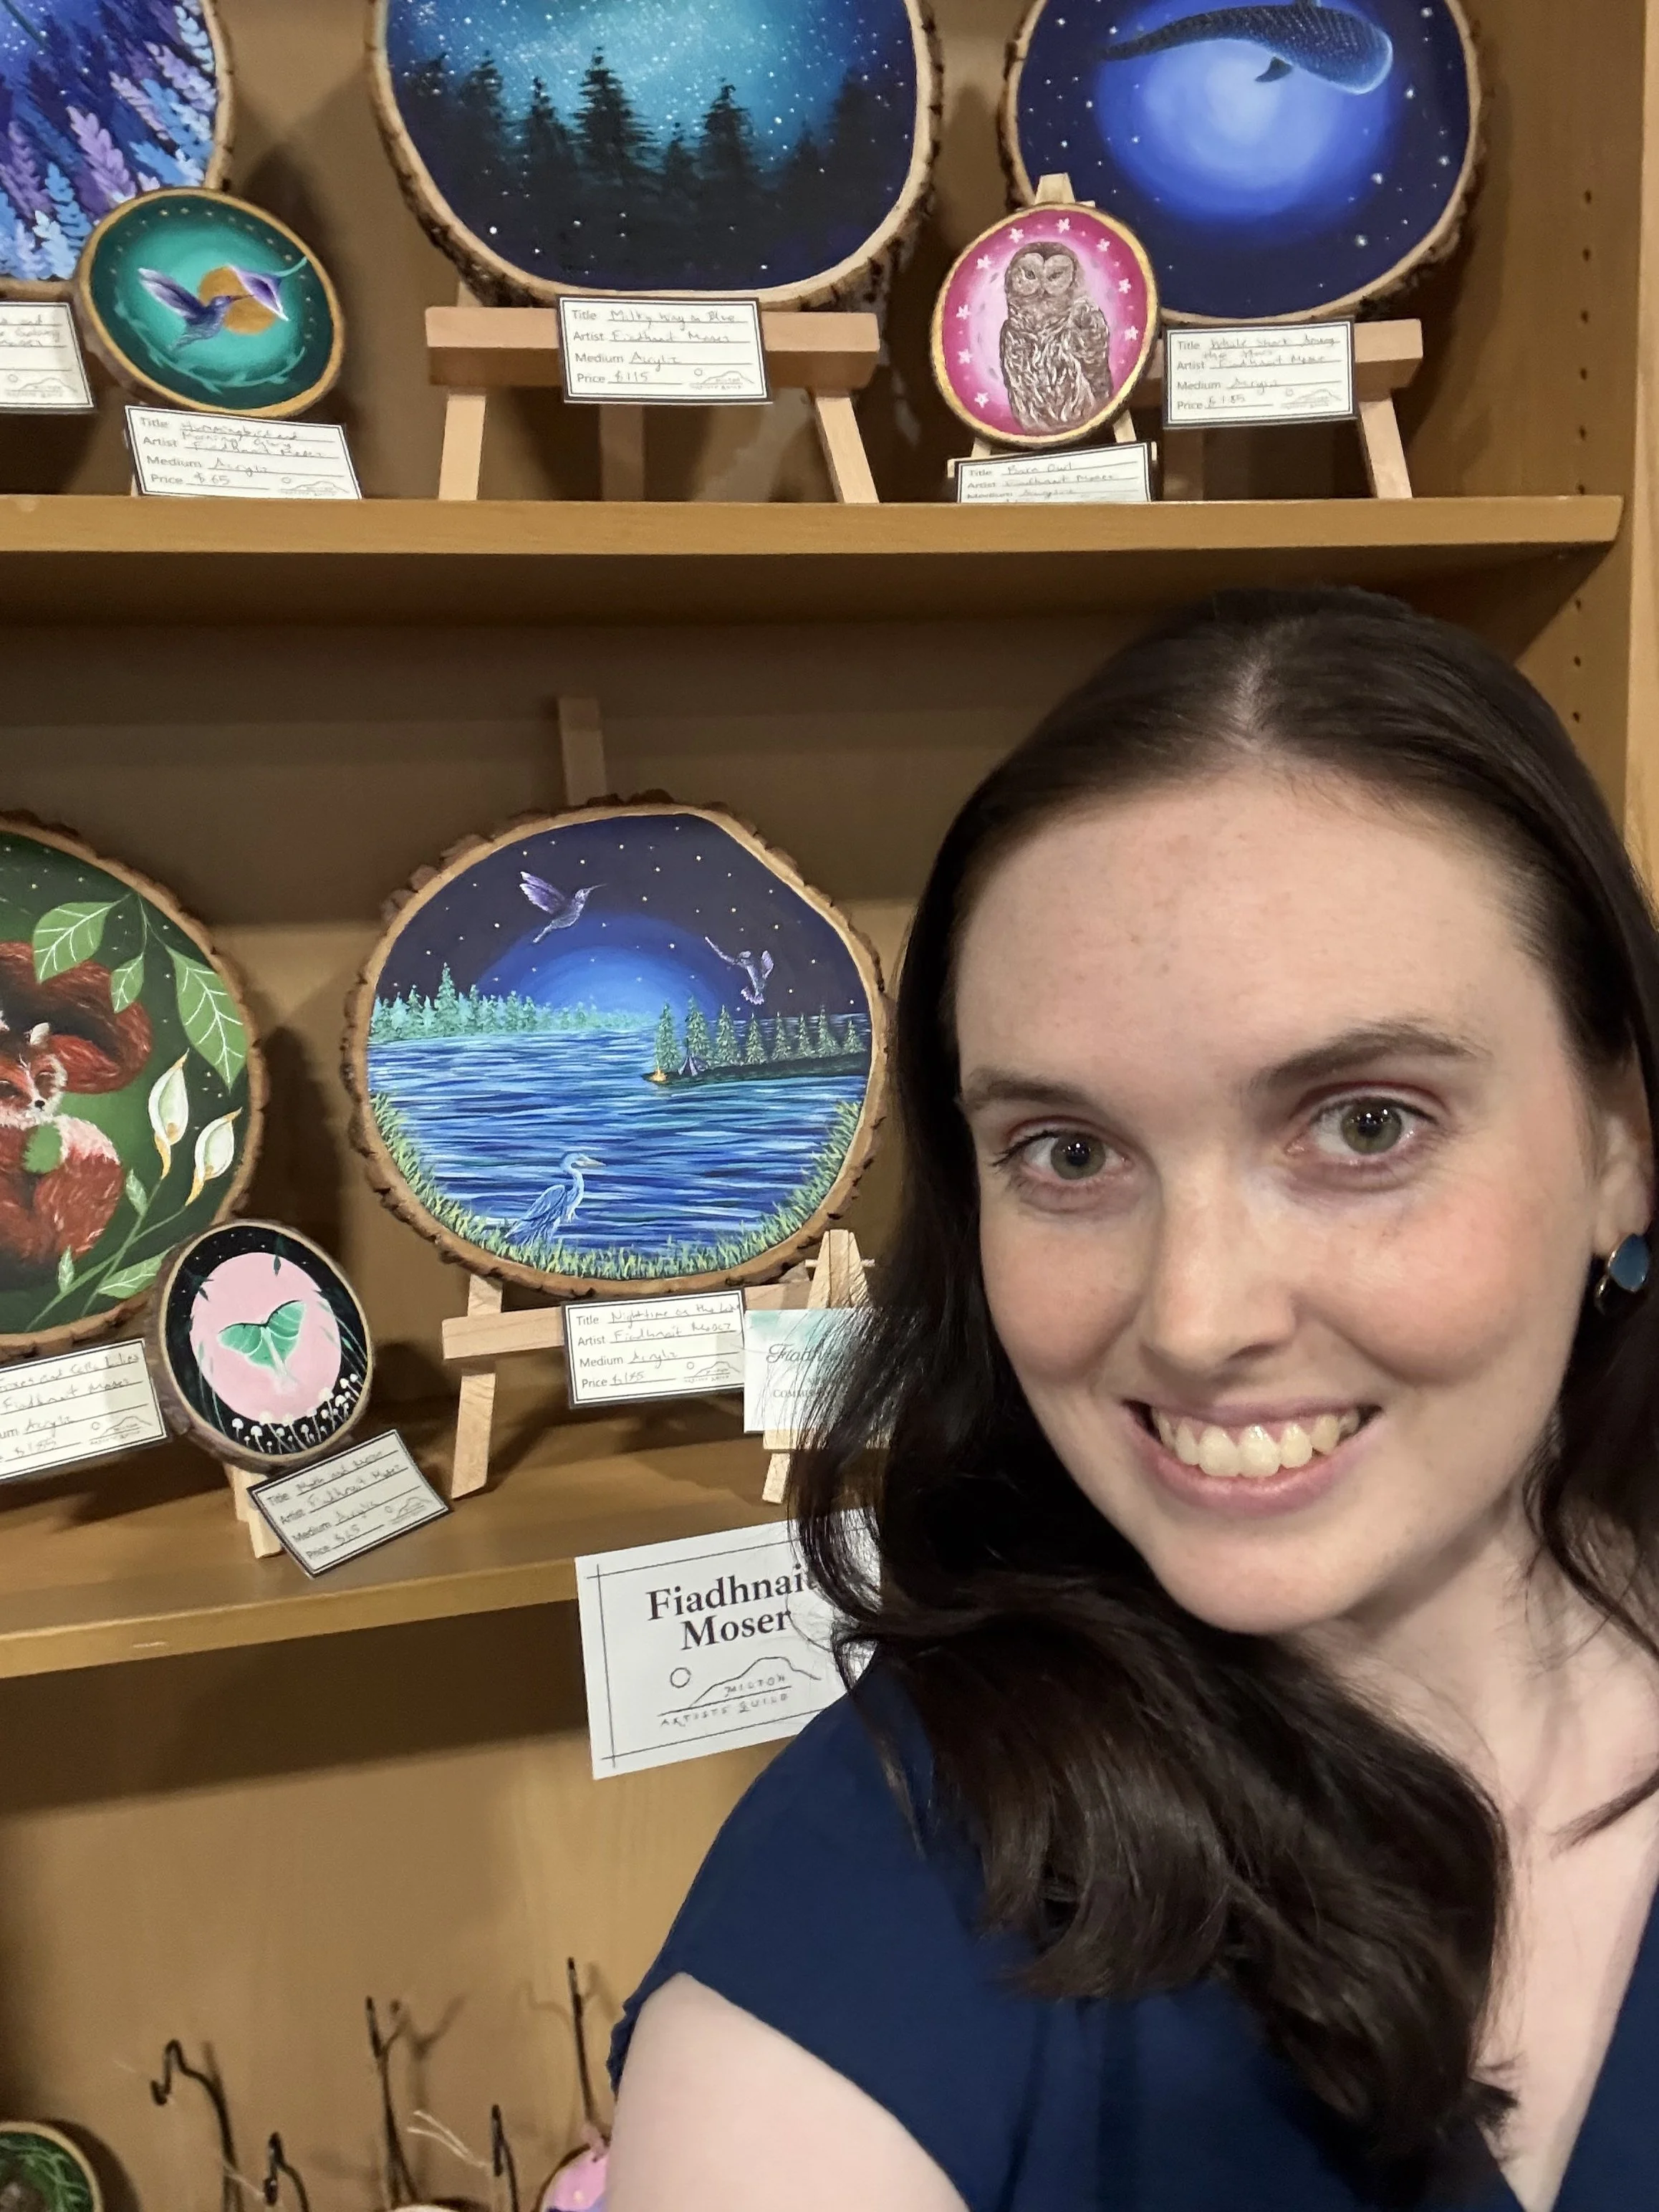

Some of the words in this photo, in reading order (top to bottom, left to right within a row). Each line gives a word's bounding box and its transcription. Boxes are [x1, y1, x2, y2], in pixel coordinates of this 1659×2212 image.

[571, 309, 597, 320] Title
[573, 331, 605, 341] Artist
[1178, 340, 1200, 350] Title
[574, 352, 624, 362] Medium
[1177, 360, 1205, 370] Artist
[577, 373, 606, 383] Price
[1177, 381, 1221, 390] Medium
[1177, 401, 1203, 410] Price
[141, 417, 168, 428] Title
[143, 436, 177, 448] Artist
[147, 455, 201, 468] Medium
[150, 473, 183, 485] Price
[576, 1315, 599, 1325] Title
[577, 1337, 606, 1346] Artist
[580, 1357, 623, 1367] Medium
[582, 1378, 607, 1389] Price
[266, 1492, 290, 1506] Title
[280, 1508, 305, 1524] Artist
[292, 1521, 332, 1542] Medium
[306, 1544, 331, 1559] Price
[681, 1610, 792, 1651] Moser
